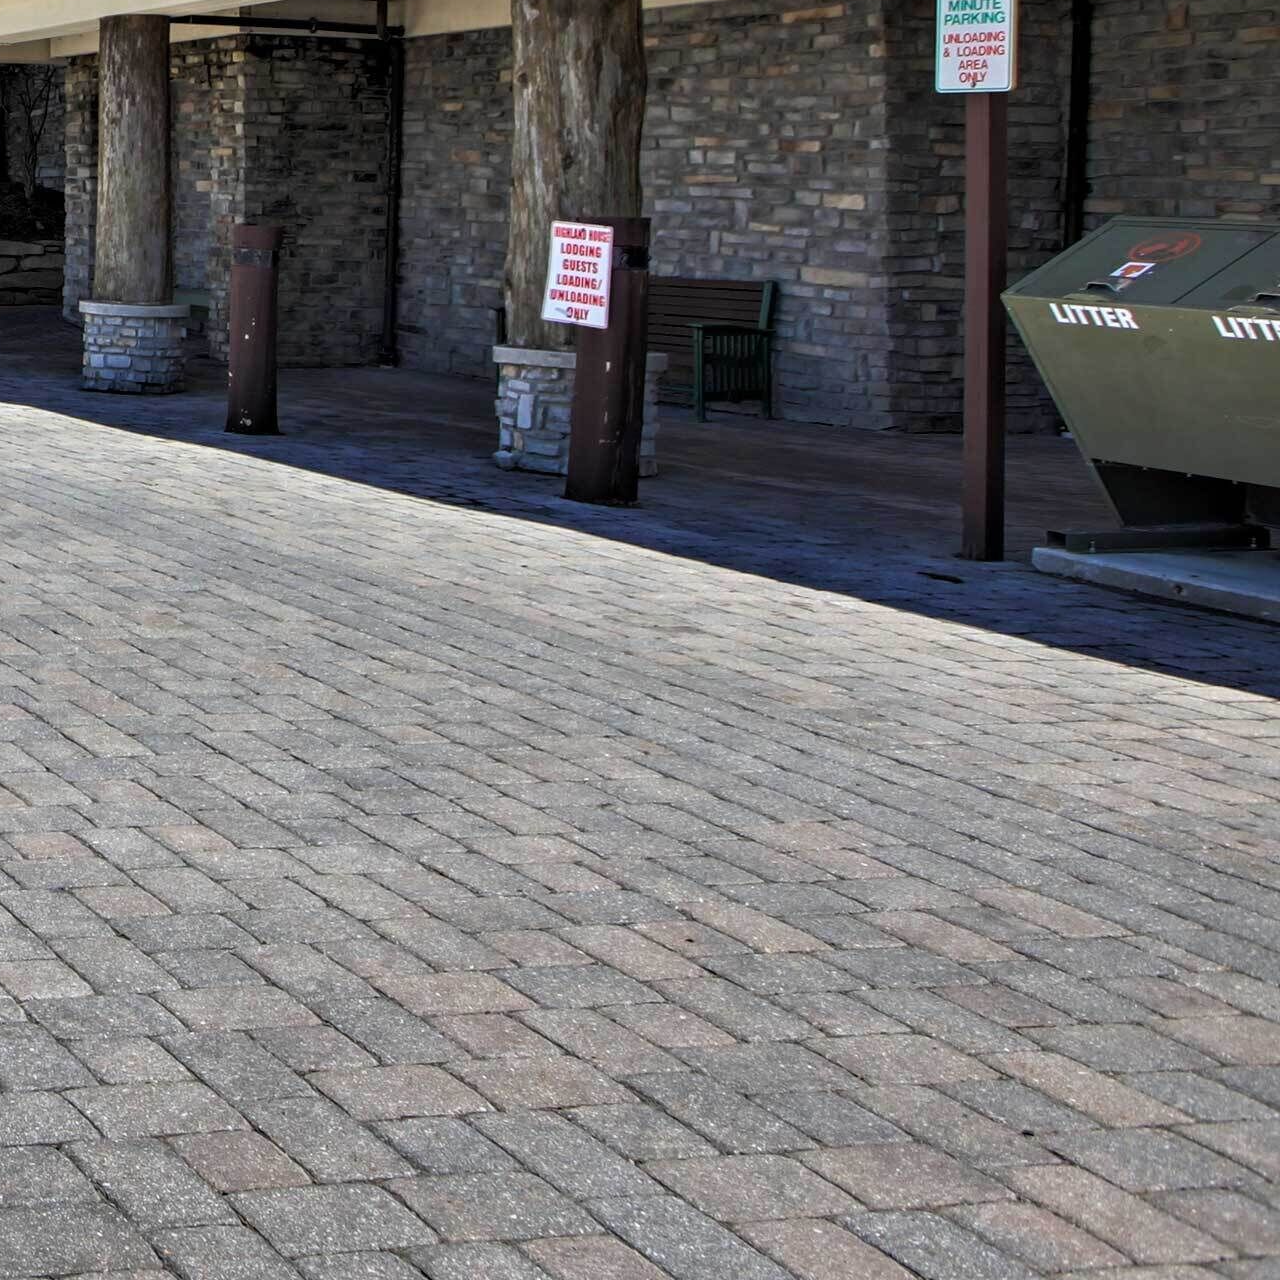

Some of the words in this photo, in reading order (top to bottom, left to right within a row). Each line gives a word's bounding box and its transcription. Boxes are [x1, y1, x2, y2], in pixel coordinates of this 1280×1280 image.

[944, 11, 1006, 26] PARKING
[943, 31, 1006, 45] UNLOADING
[943, 47, 951, 58] &
[956, 44, 1006, 57] LOADING
[958, 59, 989, 70] AREA
[959, 71, 988, 84] ONLY
[560, 242, 603, 258] LODGING
[562, 258, 599, 274] GUESTS
[556, 274, 603, 291] LOADING/
[549, 288, 606, 308] UNLOADING
[566, 306, 591, 322] ONLY
[1049, 302, 1140, 330] LITTER
